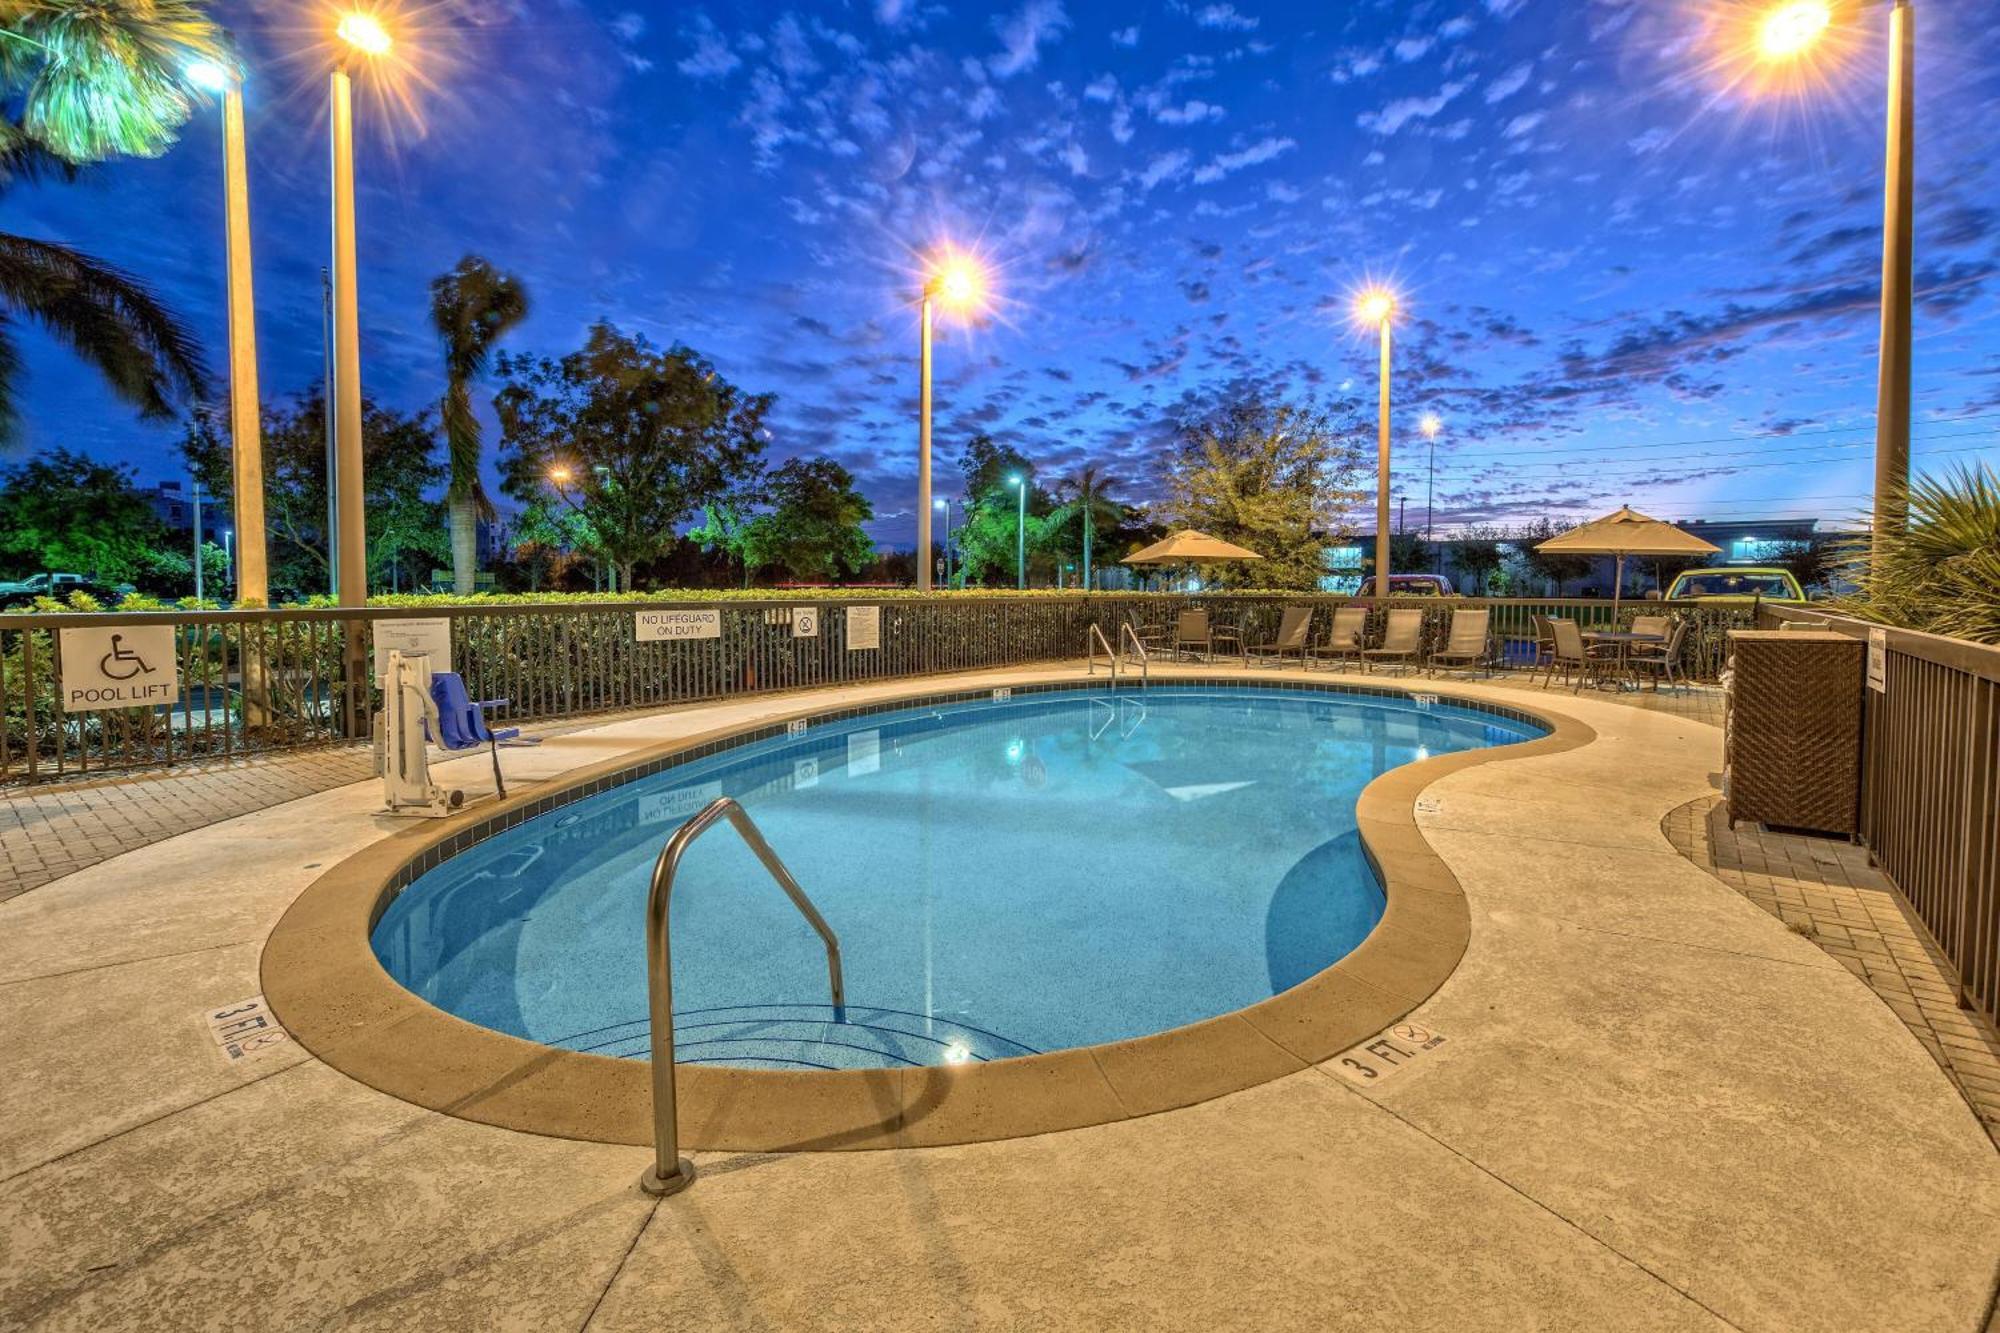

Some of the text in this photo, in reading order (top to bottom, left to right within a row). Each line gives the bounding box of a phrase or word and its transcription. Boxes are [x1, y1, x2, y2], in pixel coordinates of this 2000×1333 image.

[642, 613, 715, 625] NO LIFEGUARD
[657, 625, 702, 635] ON DUTY
[71, 684, 170, 703] POOL LIFT
[214, 1003, 258, 1019] 3
[1341, 1058, 1378, 1078] 3
